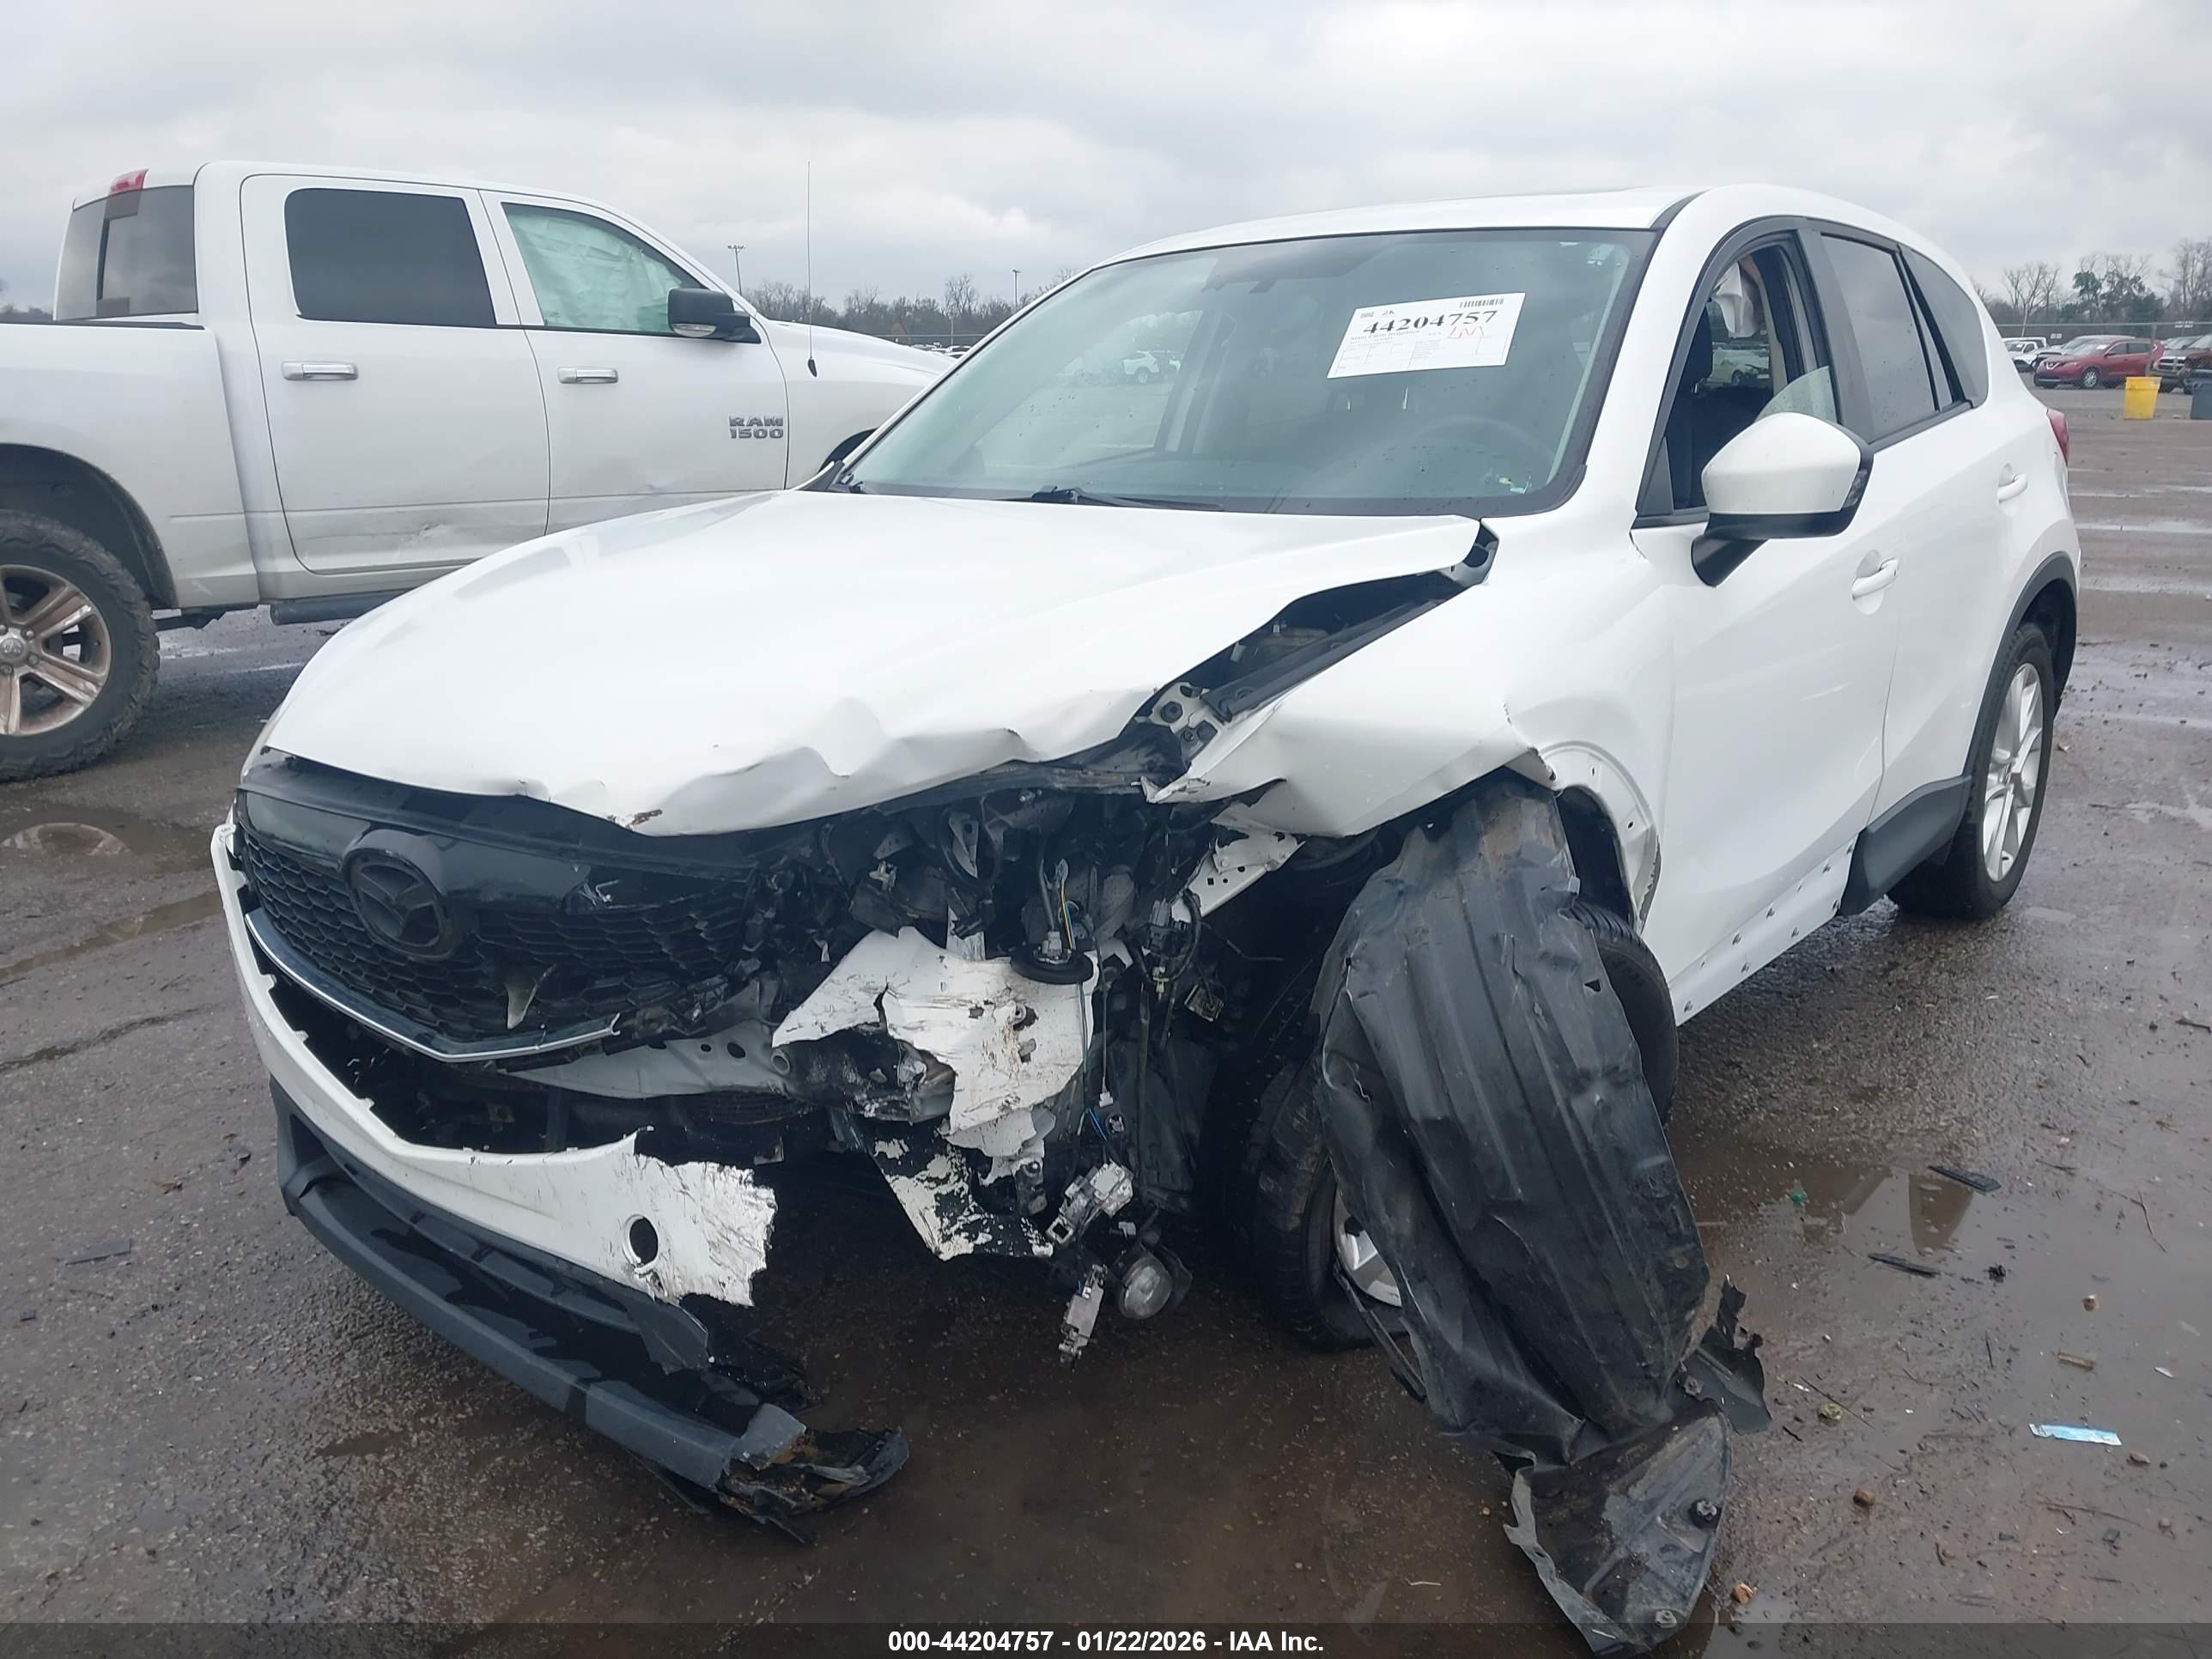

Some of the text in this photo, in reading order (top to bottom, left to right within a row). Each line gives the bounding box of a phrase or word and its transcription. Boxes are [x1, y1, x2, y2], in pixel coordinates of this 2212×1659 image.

[1363, 310, 1498, 334] 44204757
[729, 416, 784, 427] RAM
[729, 428, 784, 439] 1500
